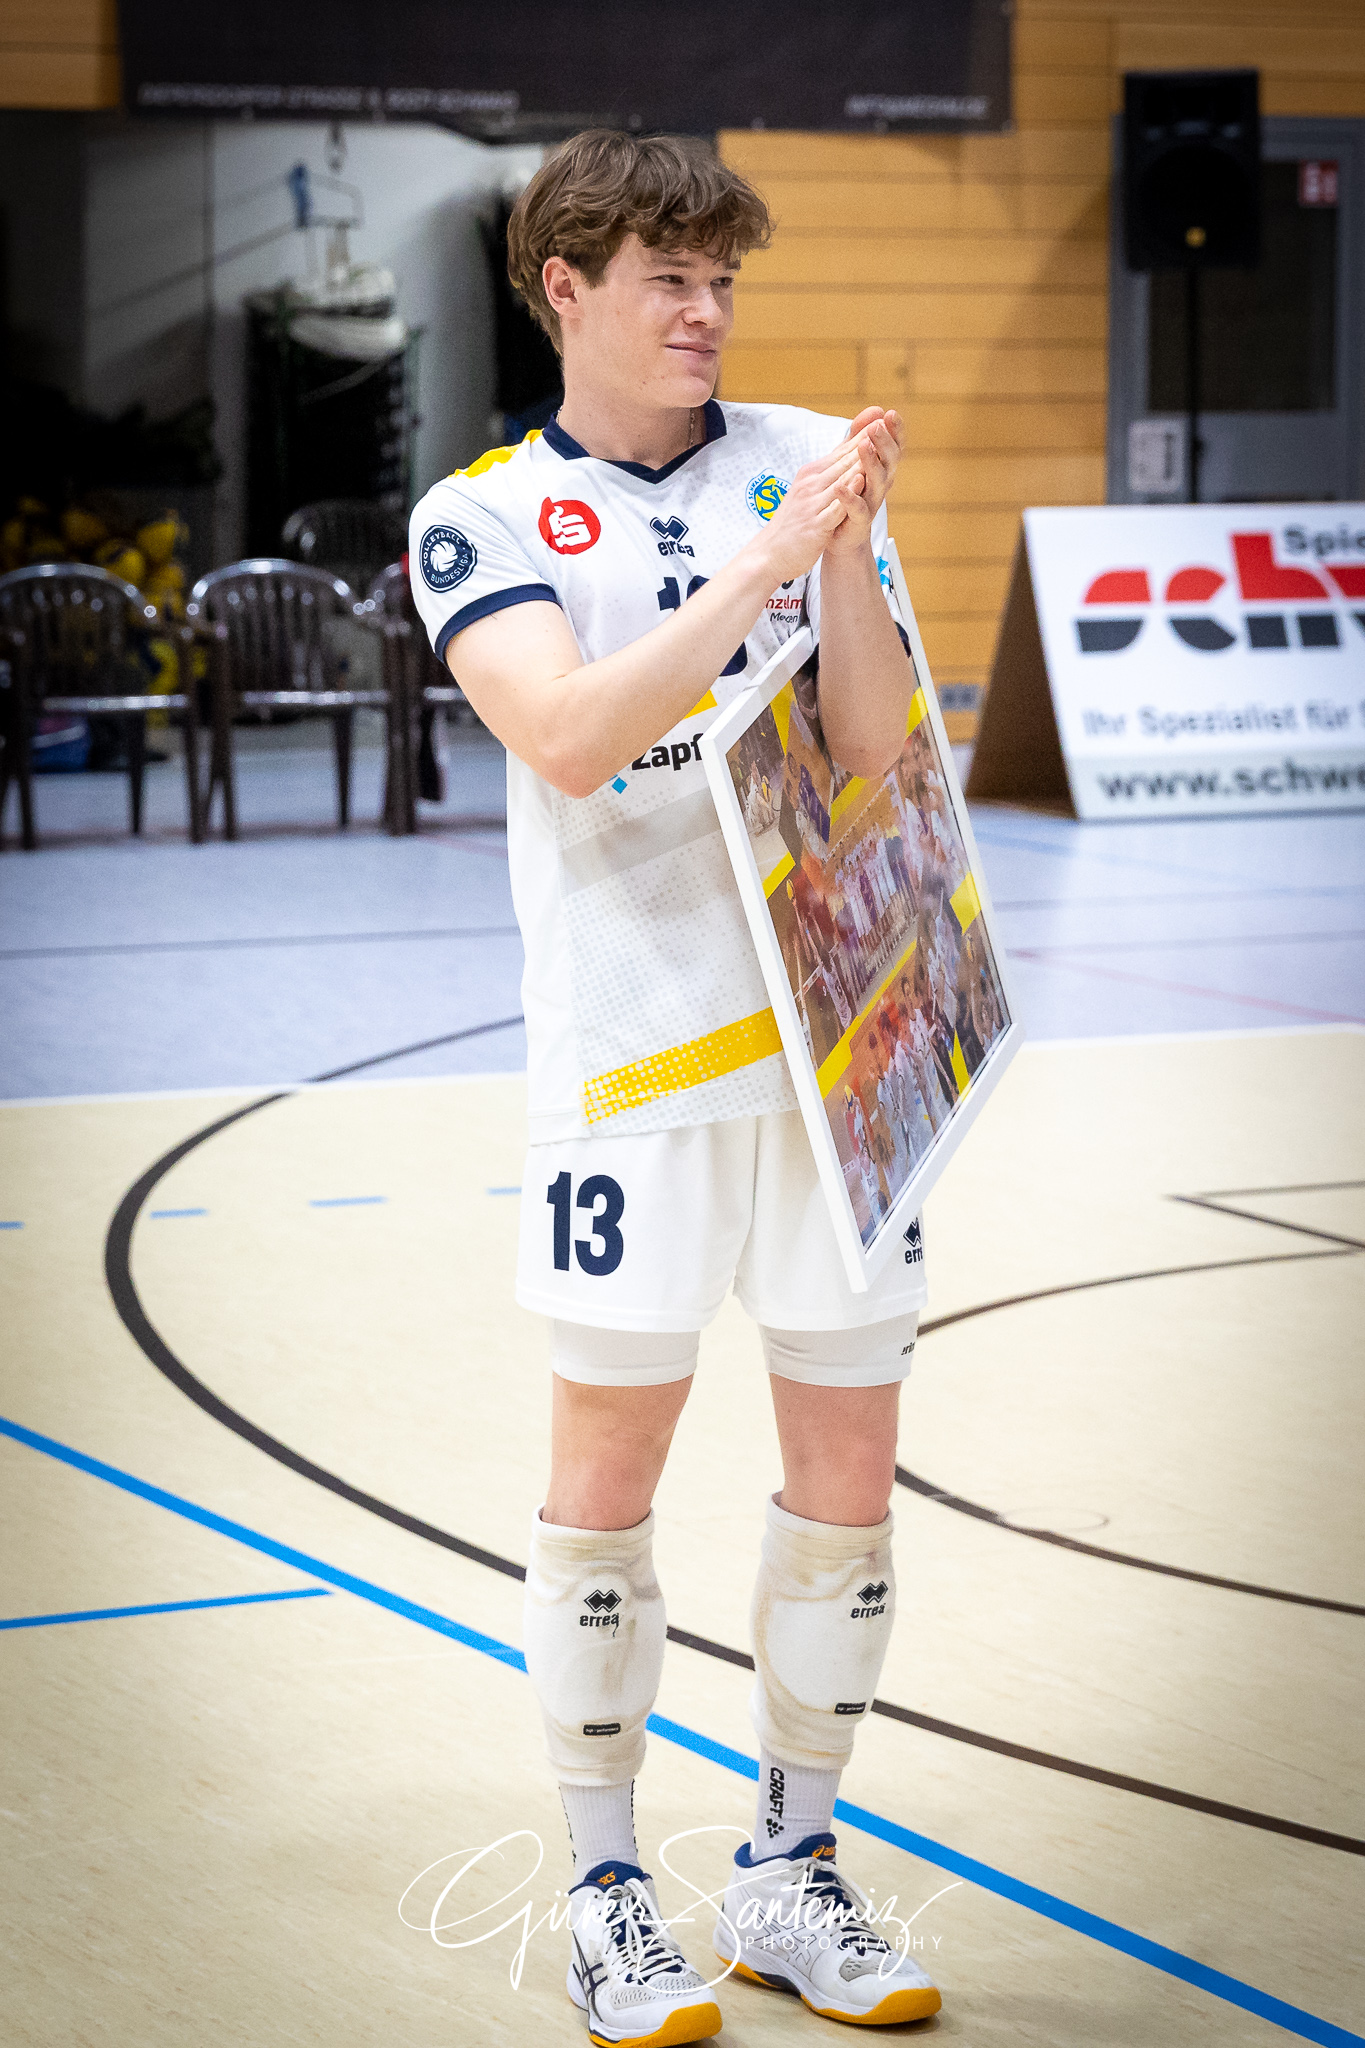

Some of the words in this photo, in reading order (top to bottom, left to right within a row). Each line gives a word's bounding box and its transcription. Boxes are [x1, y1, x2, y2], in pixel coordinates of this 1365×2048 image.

[423, 531, 460, 567] VOLLEYBALL
[430, 553, 469, 584] BUNDESLIGA
[1138, 705, 1296, 739] Spezialist
[547, 1171, 625, 1277] 13
[769, 1767, 785, 1819] CRAFT
